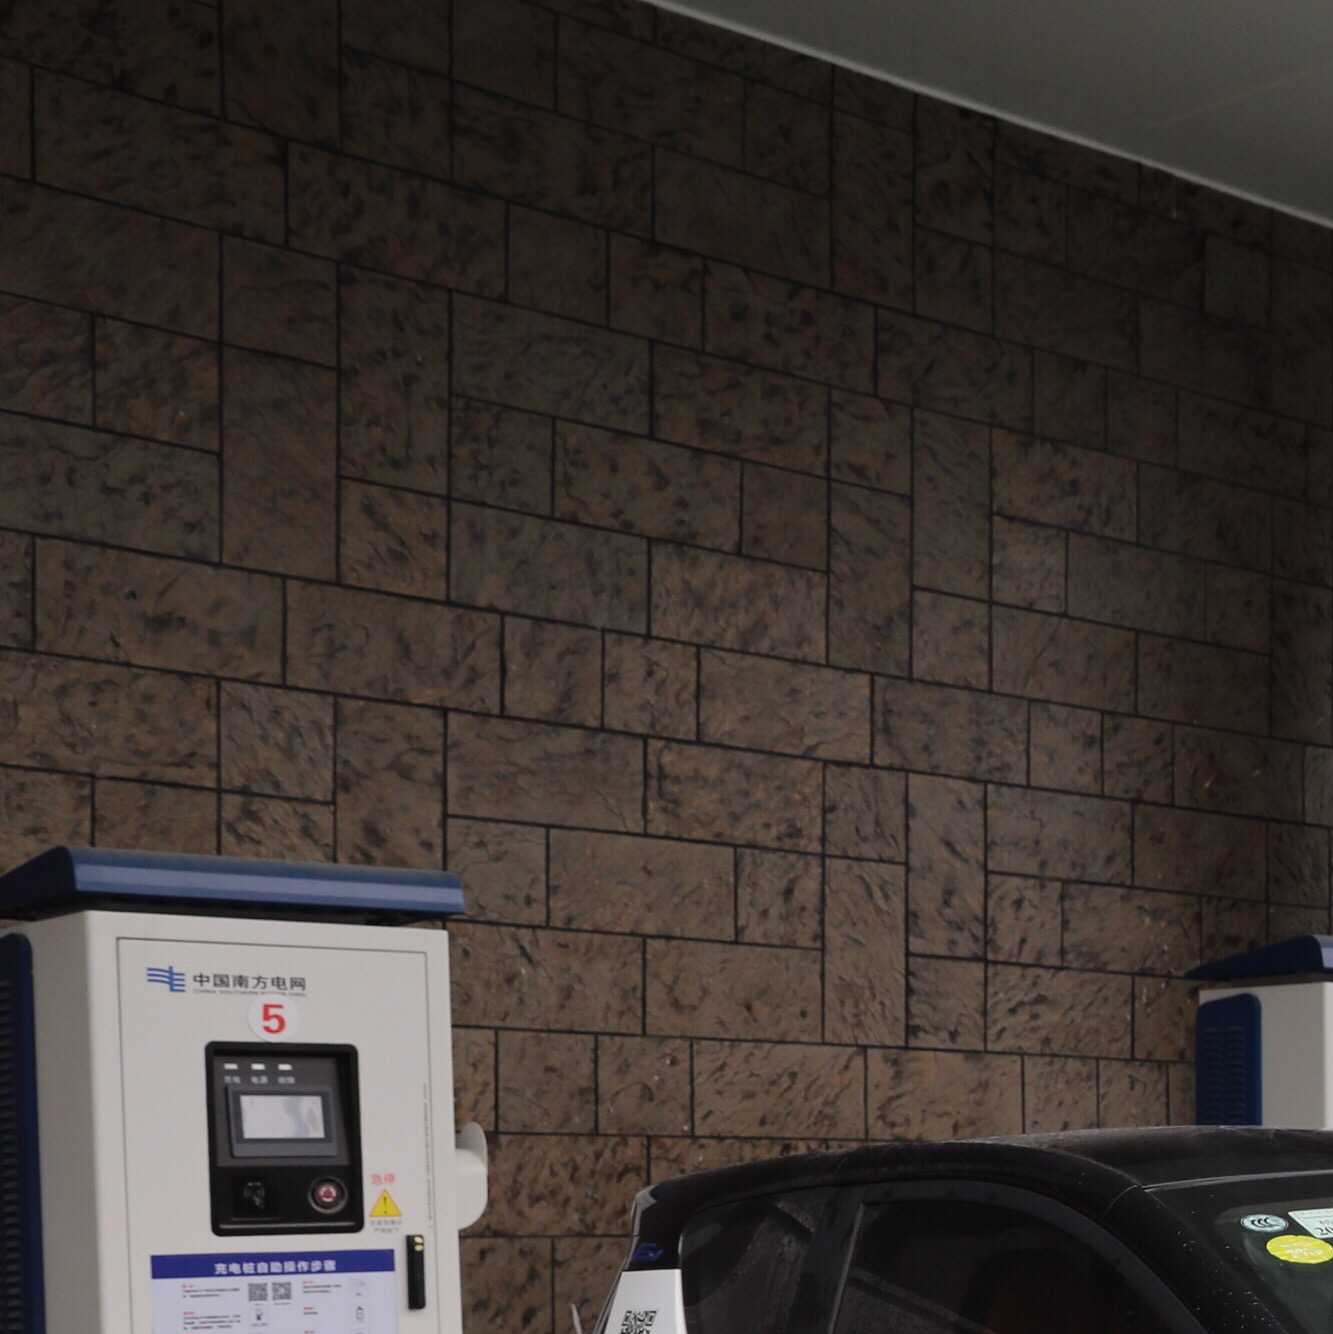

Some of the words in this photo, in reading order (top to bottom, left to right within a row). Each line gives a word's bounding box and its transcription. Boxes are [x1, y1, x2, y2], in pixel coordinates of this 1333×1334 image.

[193, 973, 307, 991] 中国南方电网
[262, 1003, 286, 1034] 5
